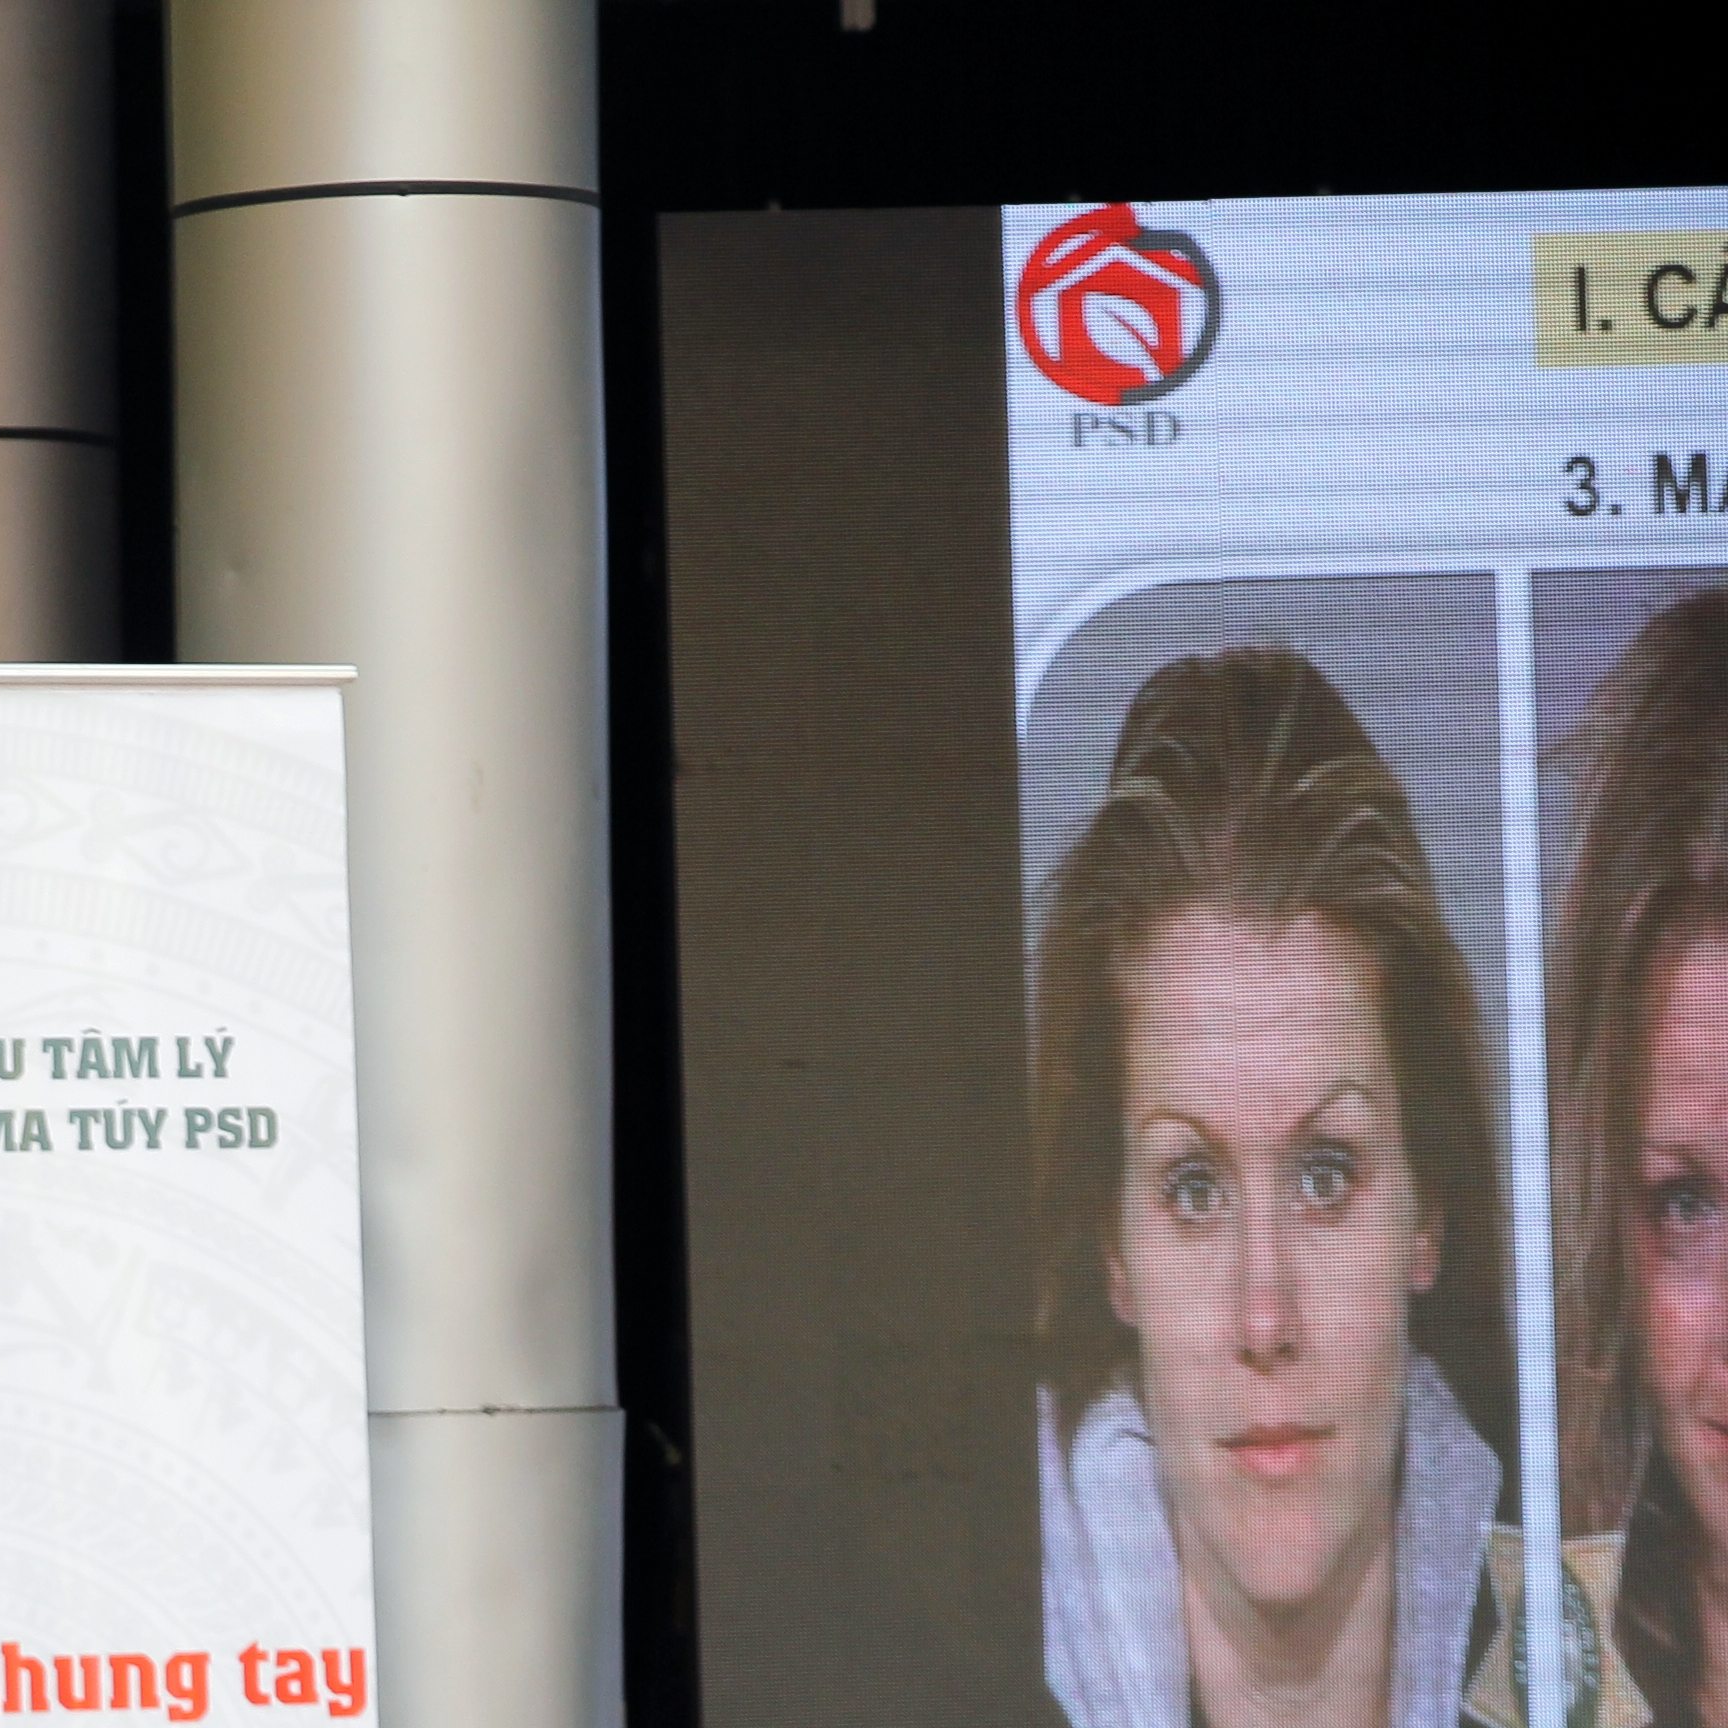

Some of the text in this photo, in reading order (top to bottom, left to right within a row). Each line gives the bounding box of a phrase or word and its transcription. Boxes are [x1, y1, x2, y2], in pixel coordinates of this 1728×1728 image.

[1070, 410, 1183, 448] PSD
[1562, 451, 1728, 517] 3. M
[43, 1029, 159, 1079] TÂM
[176, 1028, 233, 1078] LÝ
[69, 1101, 167, 1150] TÚY
[184, 1108, 277, 1149] PSD
[239, 1644, 366, 1717] tay
